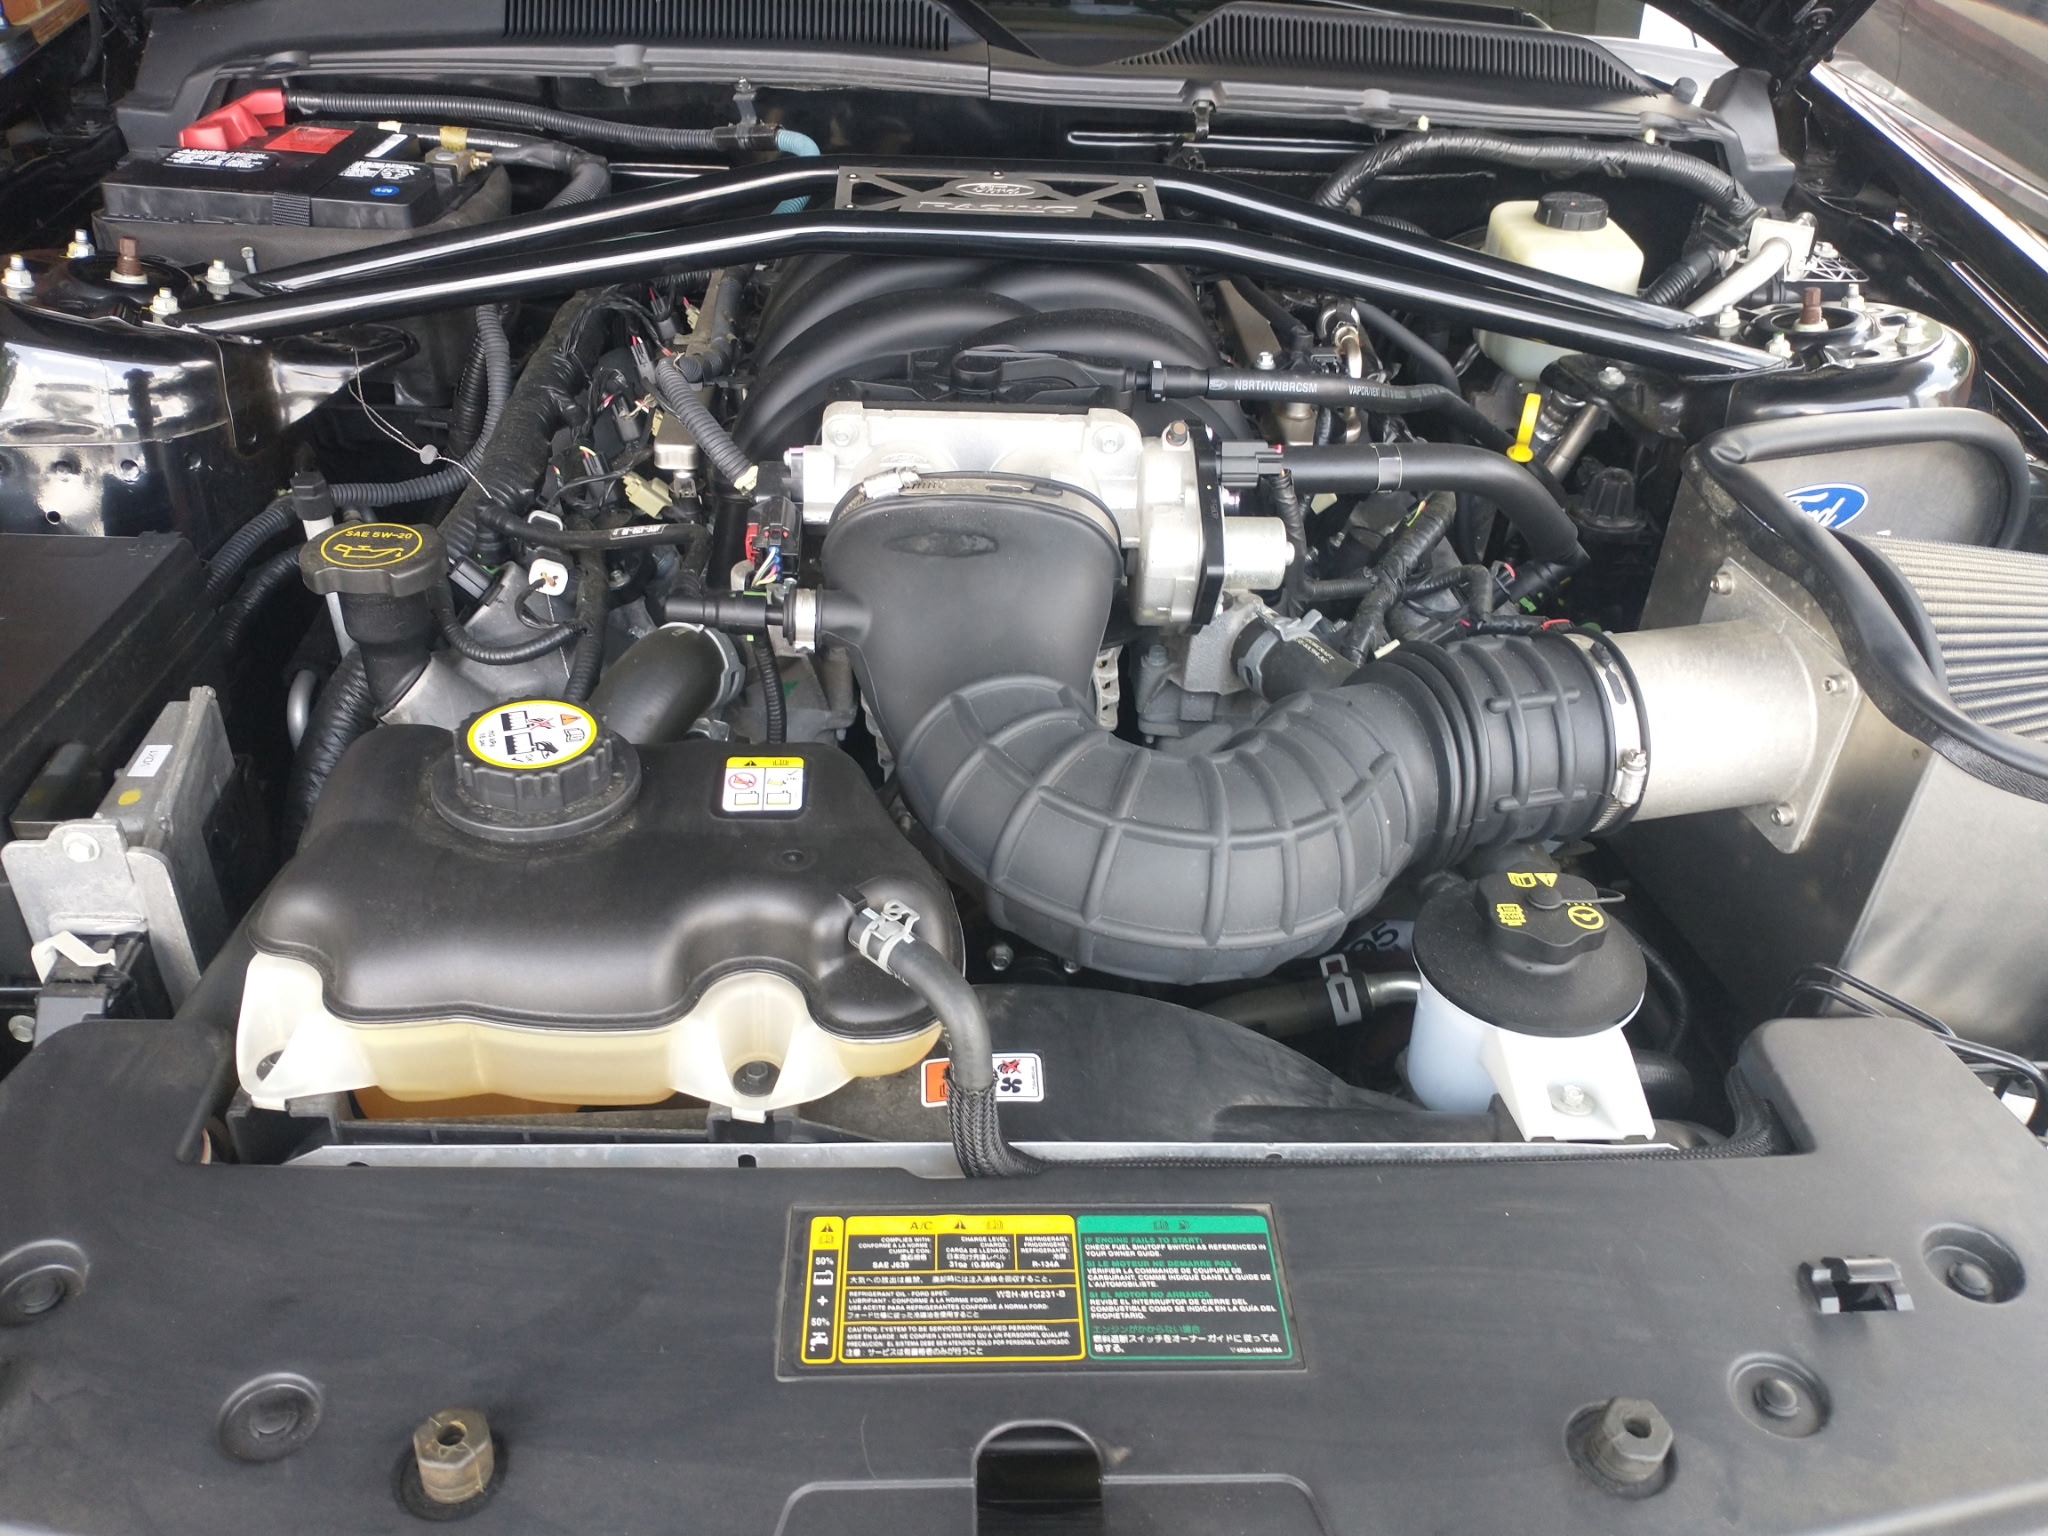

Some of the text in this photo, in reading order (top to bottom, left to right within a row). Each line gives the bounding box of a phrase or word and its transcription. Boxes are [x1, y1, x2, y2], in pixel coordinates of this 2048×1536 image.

[973, 183, 1020, 195] Ford
[345, 530, 413, 539] SAE 5W-20
[910, 1221, 933, 1230] A/C
[815, 1257, 834, 1265] 50%
[872, 1261, 889, 1269] SAE
[811, 1318, 830, 1326] 50%
